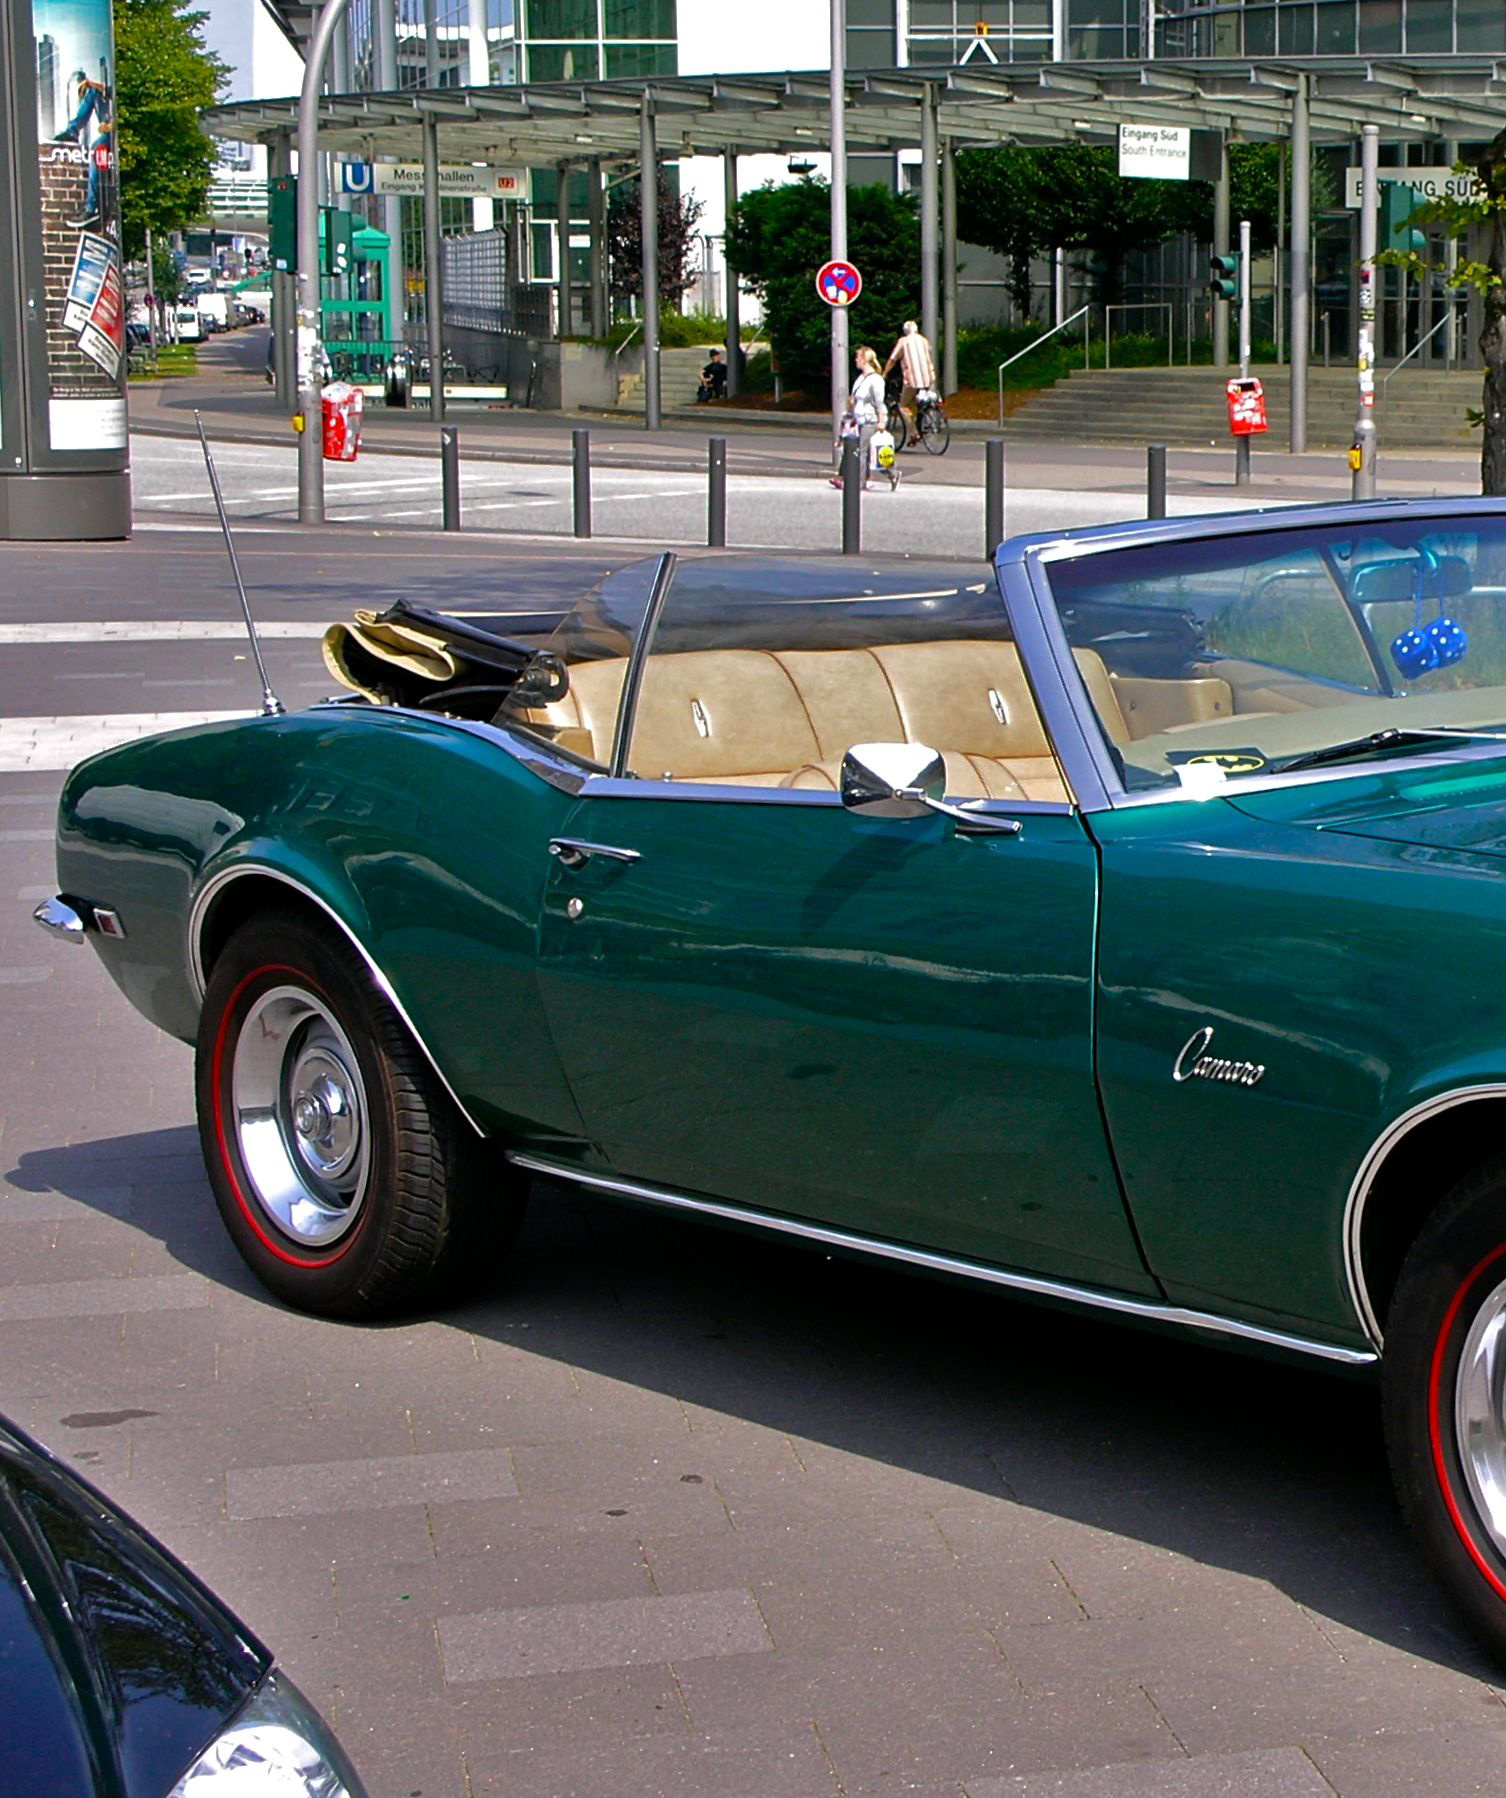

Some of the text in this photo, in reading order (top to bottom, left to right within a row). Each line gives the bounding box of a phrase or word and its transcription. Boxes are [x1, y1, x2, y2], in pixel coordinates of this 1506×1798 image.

[1122, 127, 1158, 142] Eingang
[1122, 143, 1186, 158] South Entrance
[346, 165, 370, 191] U
[1173, 1026, 1265, 1086] Camaro
